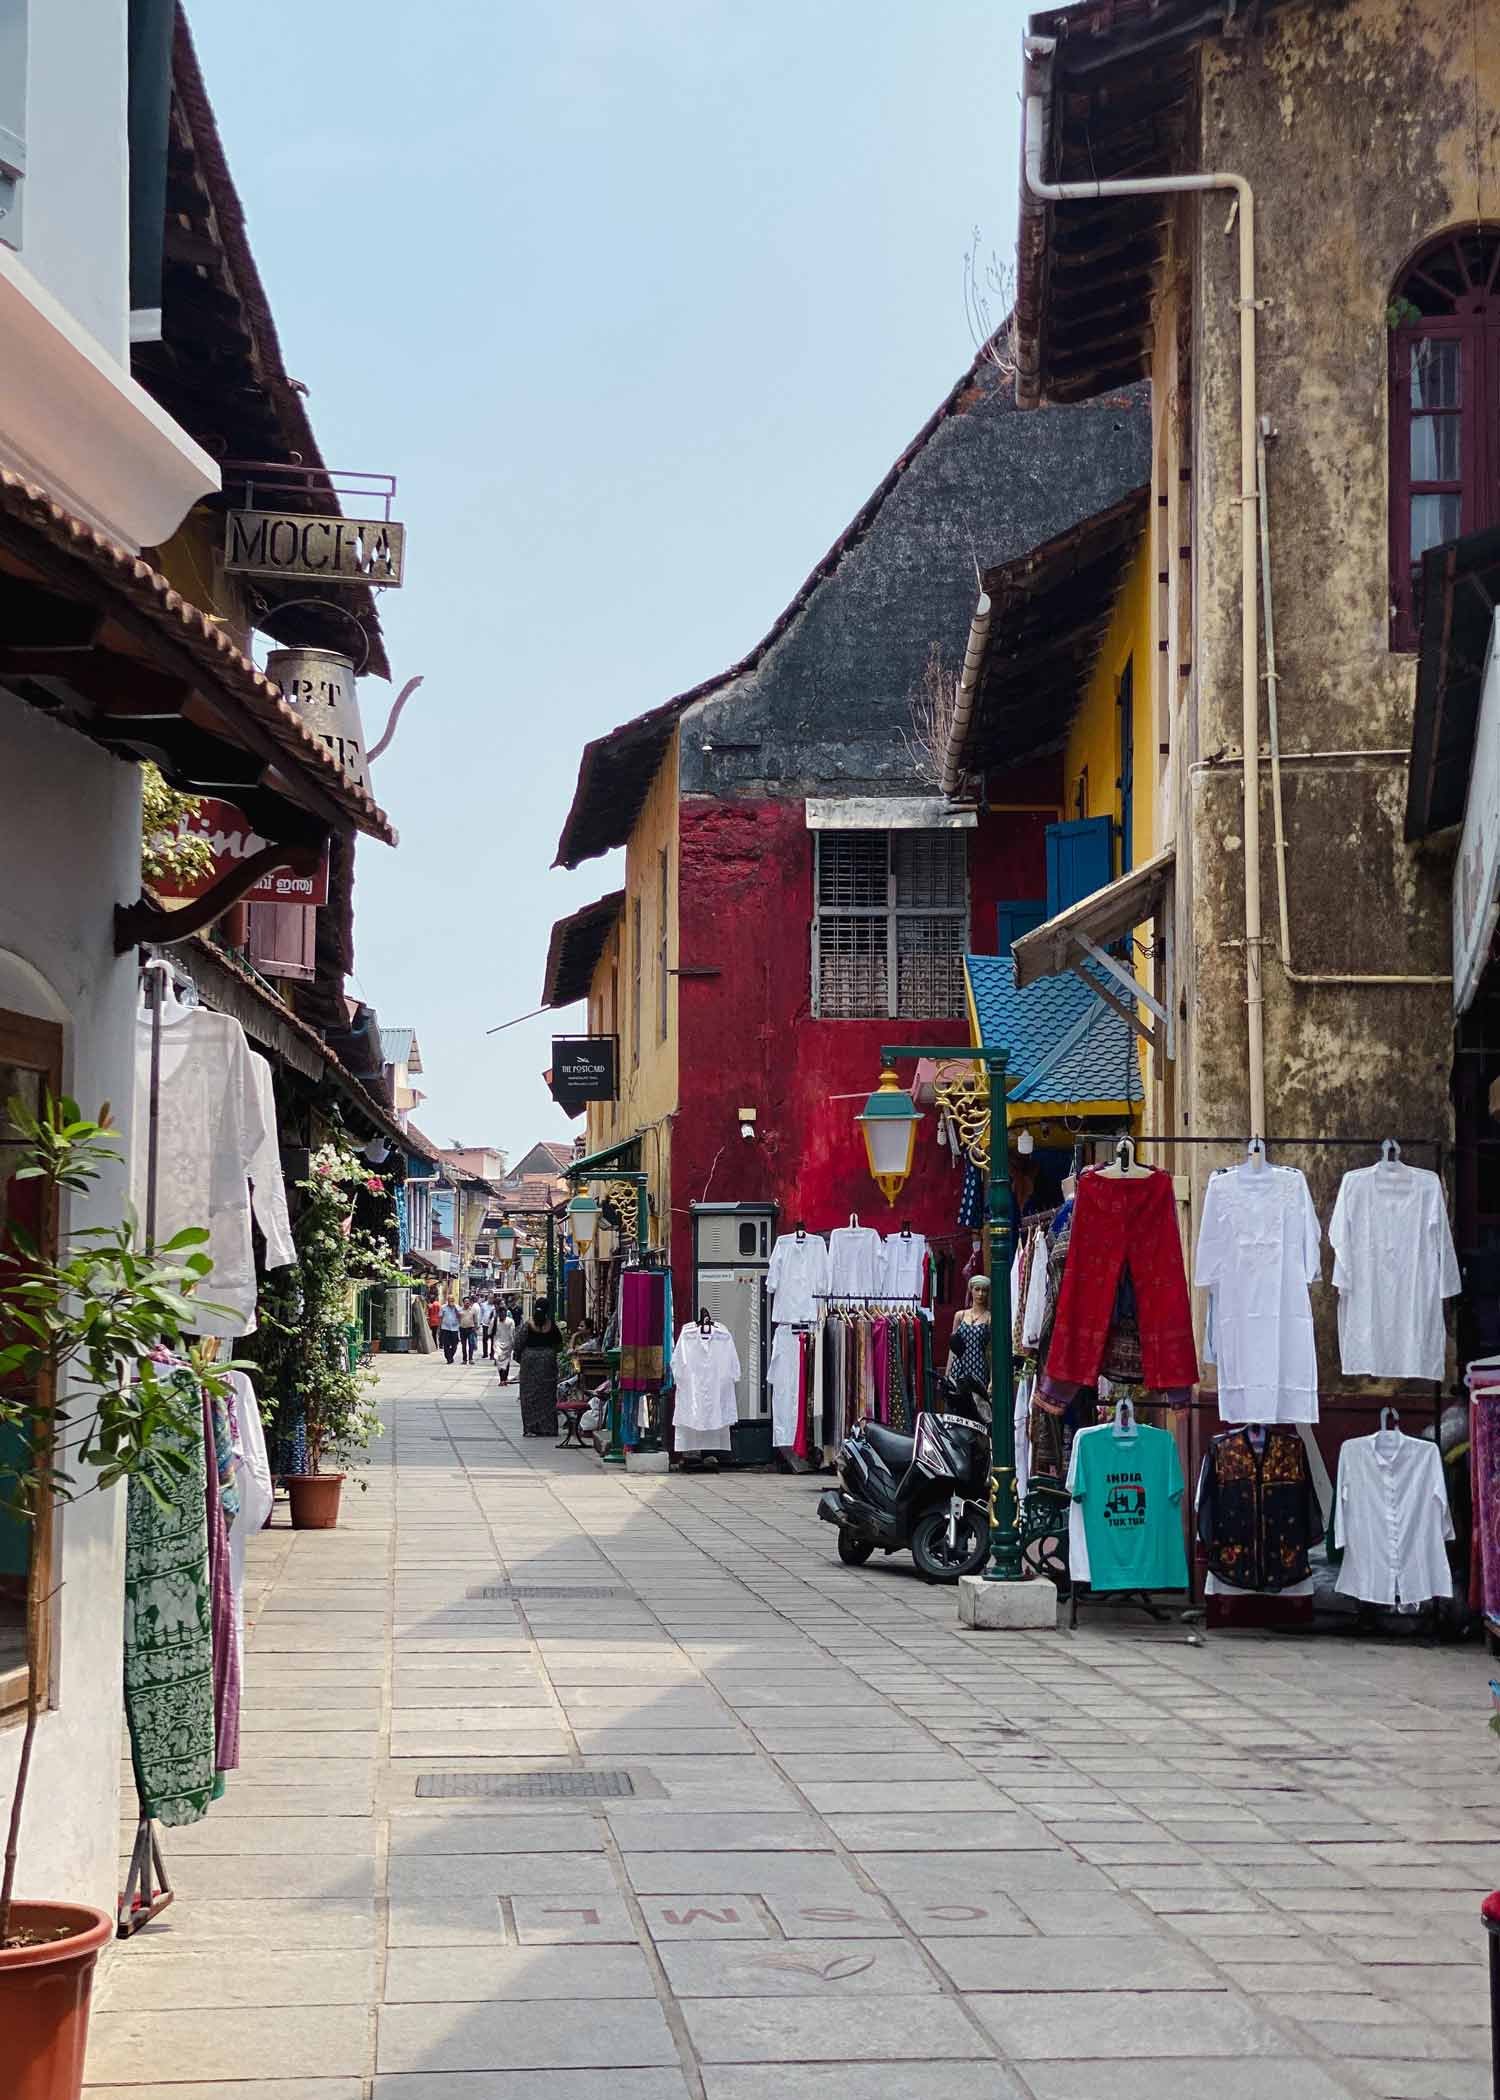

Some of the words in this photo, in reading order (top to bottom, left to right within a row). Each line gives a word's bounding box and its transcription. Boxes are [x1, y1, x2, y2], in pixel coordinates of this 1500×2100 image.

[231, 516, 397, 577] MOCHA
[572, 1064, 606, 1074] POSTCARD
[1106, 1472, 1142, 1484] INDIA
[1109, 1518, 1127, 1527] TUK
